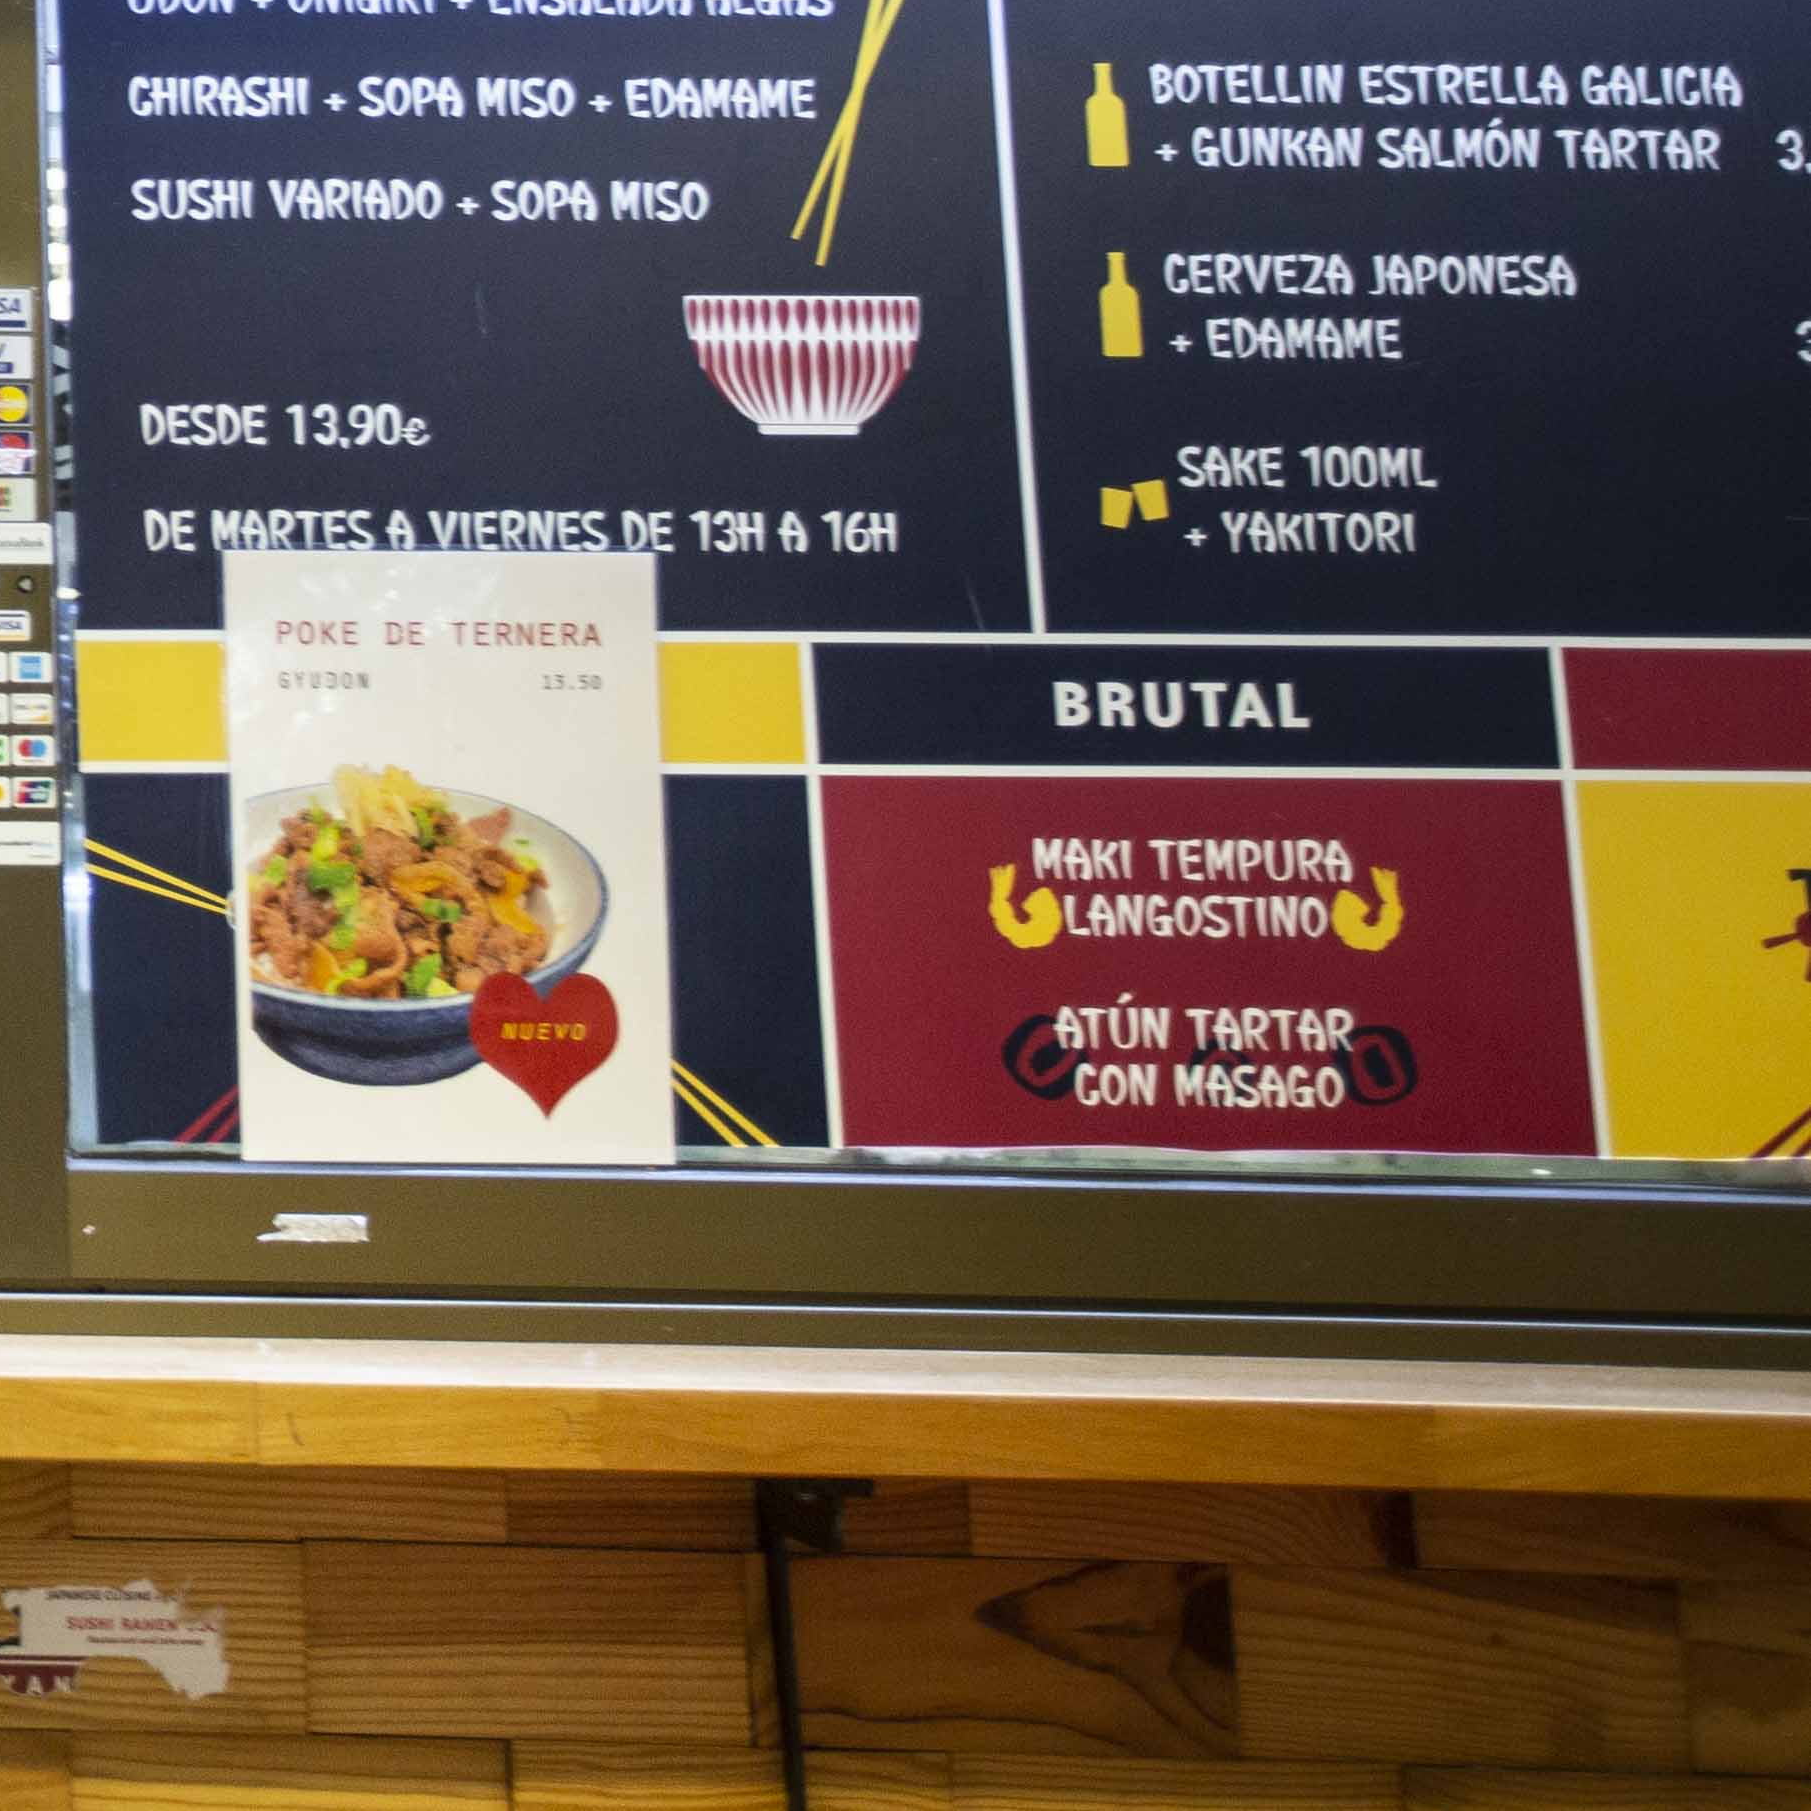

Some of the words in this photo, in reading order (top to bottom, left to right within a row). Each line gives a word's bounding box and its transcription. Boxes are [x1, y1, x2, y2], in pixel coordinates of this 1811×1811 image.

[129, 76, 309, 118] CHIRASHI
[358, 76, 464, 119] SOPA
[478, 77, 575, 119] MISO
[625, 79, 816, 120] EDAMAME
[1149, 64, 1343, 104] BOTELLIN
[1359, 65, 1569, 105] ESTRELLA
[1581, 65, 1743, 106] GALICIA
[1192, 126, 1363, 168] GUNKAN
[1377, 118, 1540, 169] SALMÓN
[1555, 128, 1720, 170] TARTAR
[131, 179, 255, 221] SUSHI
[267, 179, 443, 221] VARIADO
[491, 180, 600, 221] SOPA
[611, 180, 709, 221] MISO
[1164, 253, 1353, 295] CERVEZA
[1369, 254, 1578, 297] JAPONESA
[1206, 317, 1402, 360] EDAMAME
[139, 403, 267, 446] DESDE
[1176, 446, 1285, 488] SAKE
[1299, 446, 1438, 488] 100ML
[143, 507, 197, 550] DE
[211, 509, 374, 550] MARTES
[386, 510, 415, 550] A
[428, 510, 607, 550] VIERNES
[622, 511, 675, 551] DE
[689, 512, 765, 552] 13H
[779, 513, 808, 552] A
[822, 513, 897, 553] 16H
[1221, 511, 1416, 554] YAKITORI
[276, 621, 359, 646] POKE
[385, 622, 425, 646] DE
[453, 622, 601, 647] TERNERA
[1052, 682, 1310, 730] BRUTAL
[1032, 837, 1133, 880] MAKI
[1148, 838, 1352, 883] TEMPURA
[1065, 895, 1329, 938] LANGOSTINO
[500, 1022, 586, 1041] NUEVO
[1052, 992, 1170, 1050] ATÚN
[1186, 1007, 1354, 1052] TARTAR
[1074, 1063, 1155, 1106] CON
[1176, 1064, 1345, 1109] MASAGO
